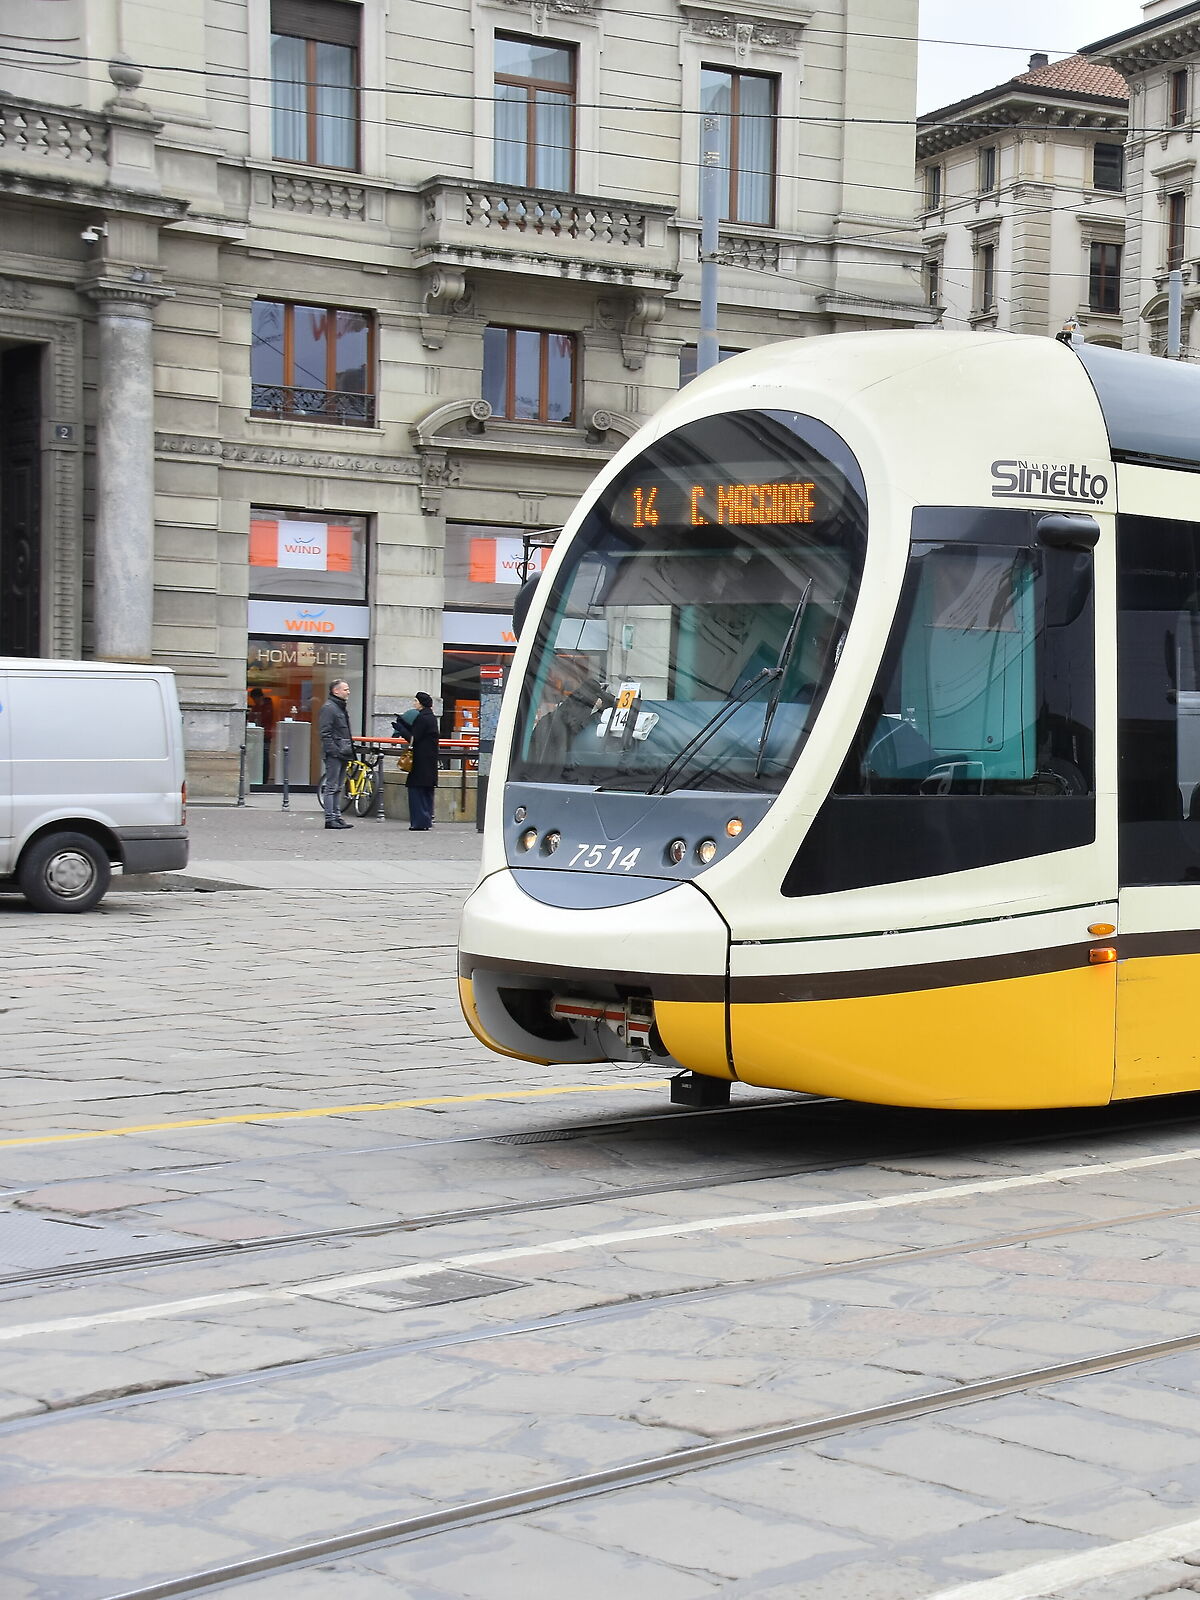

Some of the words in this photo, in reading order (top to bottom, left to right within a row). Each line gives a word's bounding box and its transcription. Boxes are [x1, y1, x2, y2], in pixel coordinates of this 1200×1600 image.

[61, 427, 68, 439] 2
[1018, 460, 1067, 472] Nuovo
[990, 459, 1108, 499] Sirietto
[632, 487, 659, 528] 14
[717, 483, 815, 525] MAGGIORE
[284, 544, 321, 555] WIND
[284, 619, 335, 633] WIND
[622, 691, 631, 707] 3
[615, 711, 628, 727] 14
[568, 843, 642, 871] 7514
